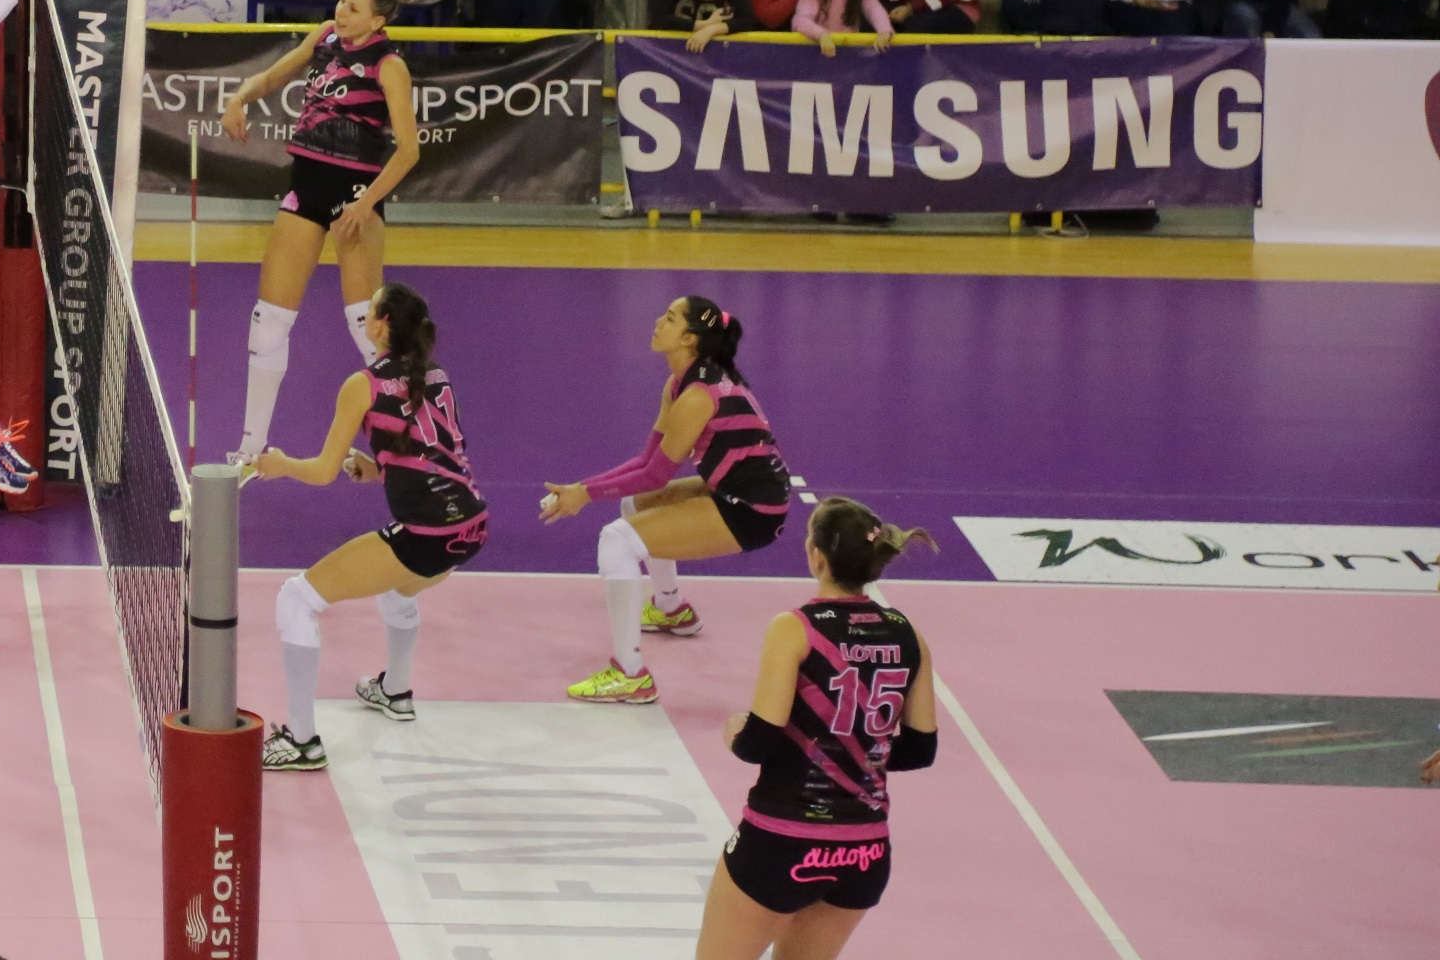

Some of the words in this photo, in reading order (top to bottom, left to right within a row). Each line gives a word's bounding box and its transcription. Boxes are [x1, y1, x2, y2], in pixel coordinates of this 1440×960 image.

[454, 78, 603, 123] SPORT
[619, 69, 1263, 180] SAMSUNG
[840, 643, 900, 663] LOTTI
[829, 667, 910, 737] 15
